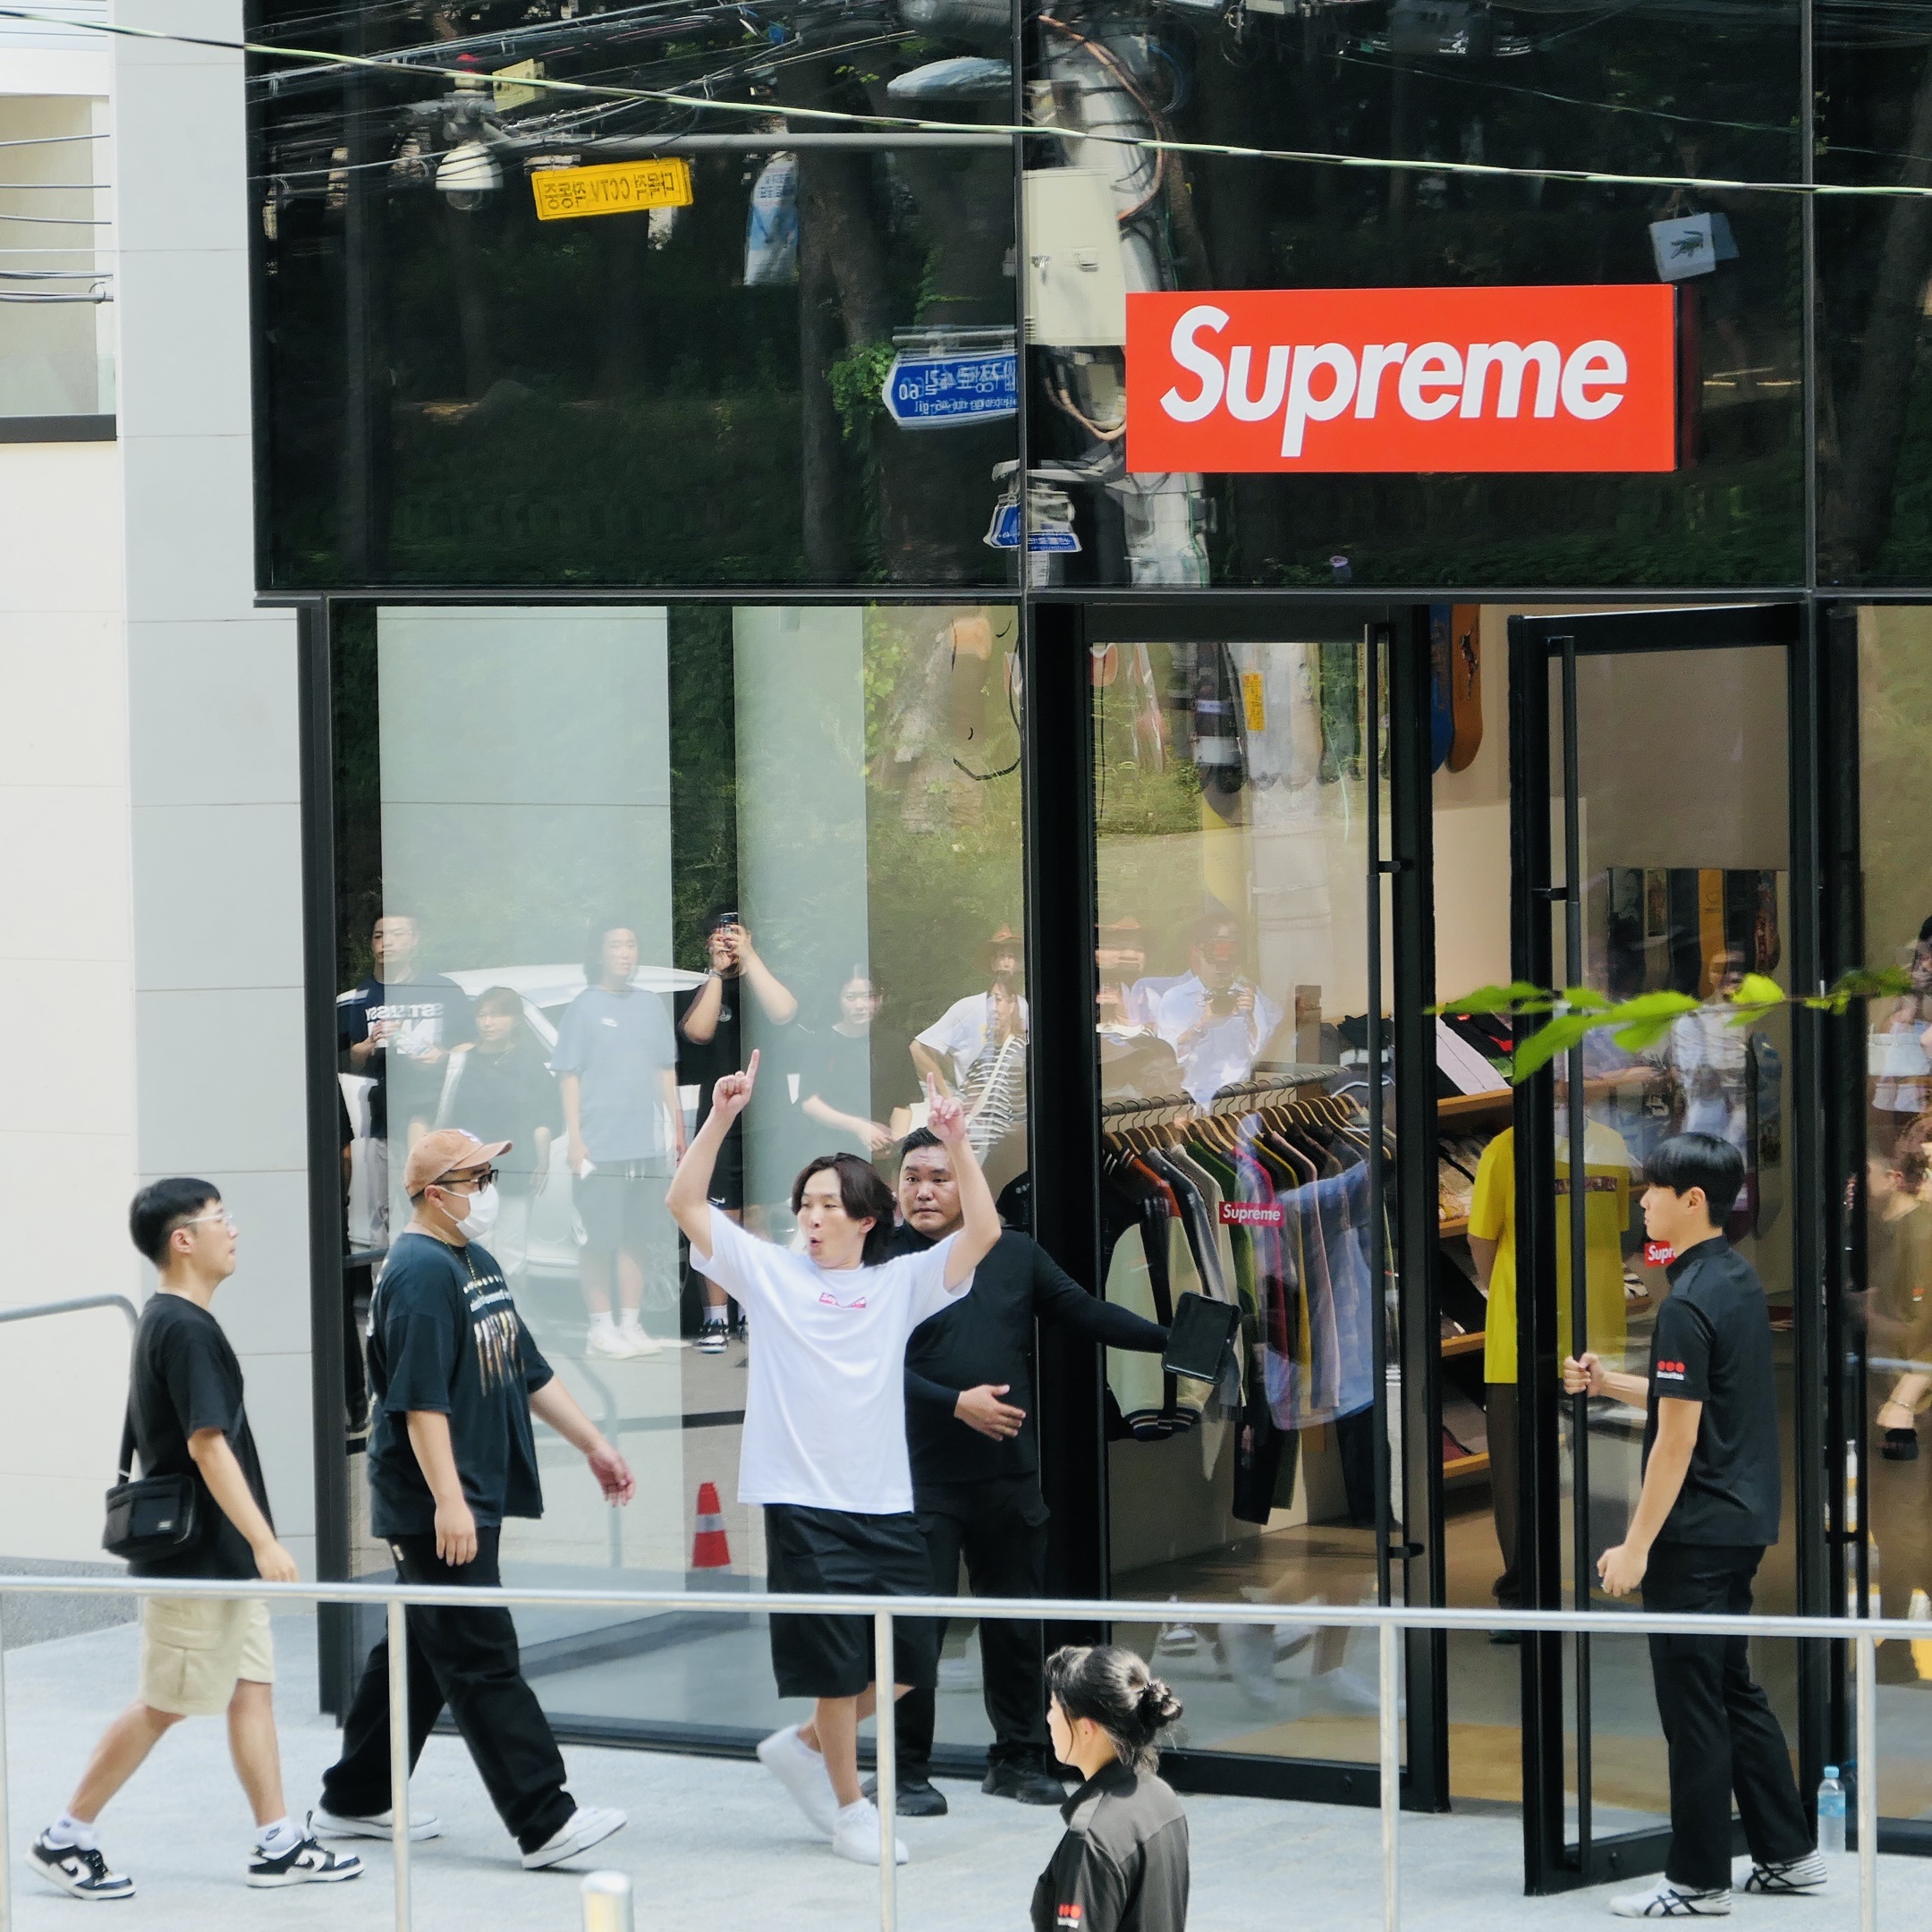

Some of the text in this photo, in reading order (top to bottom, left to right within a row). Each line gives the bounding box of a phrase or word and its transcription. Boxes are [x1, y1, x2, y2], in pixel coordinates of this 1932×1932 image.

[1159, 305, 1628, 457] Supreme
[1223, 1203, 1281, 1224] Supreme
[1648, 1244, 1677, 1265] Supr
